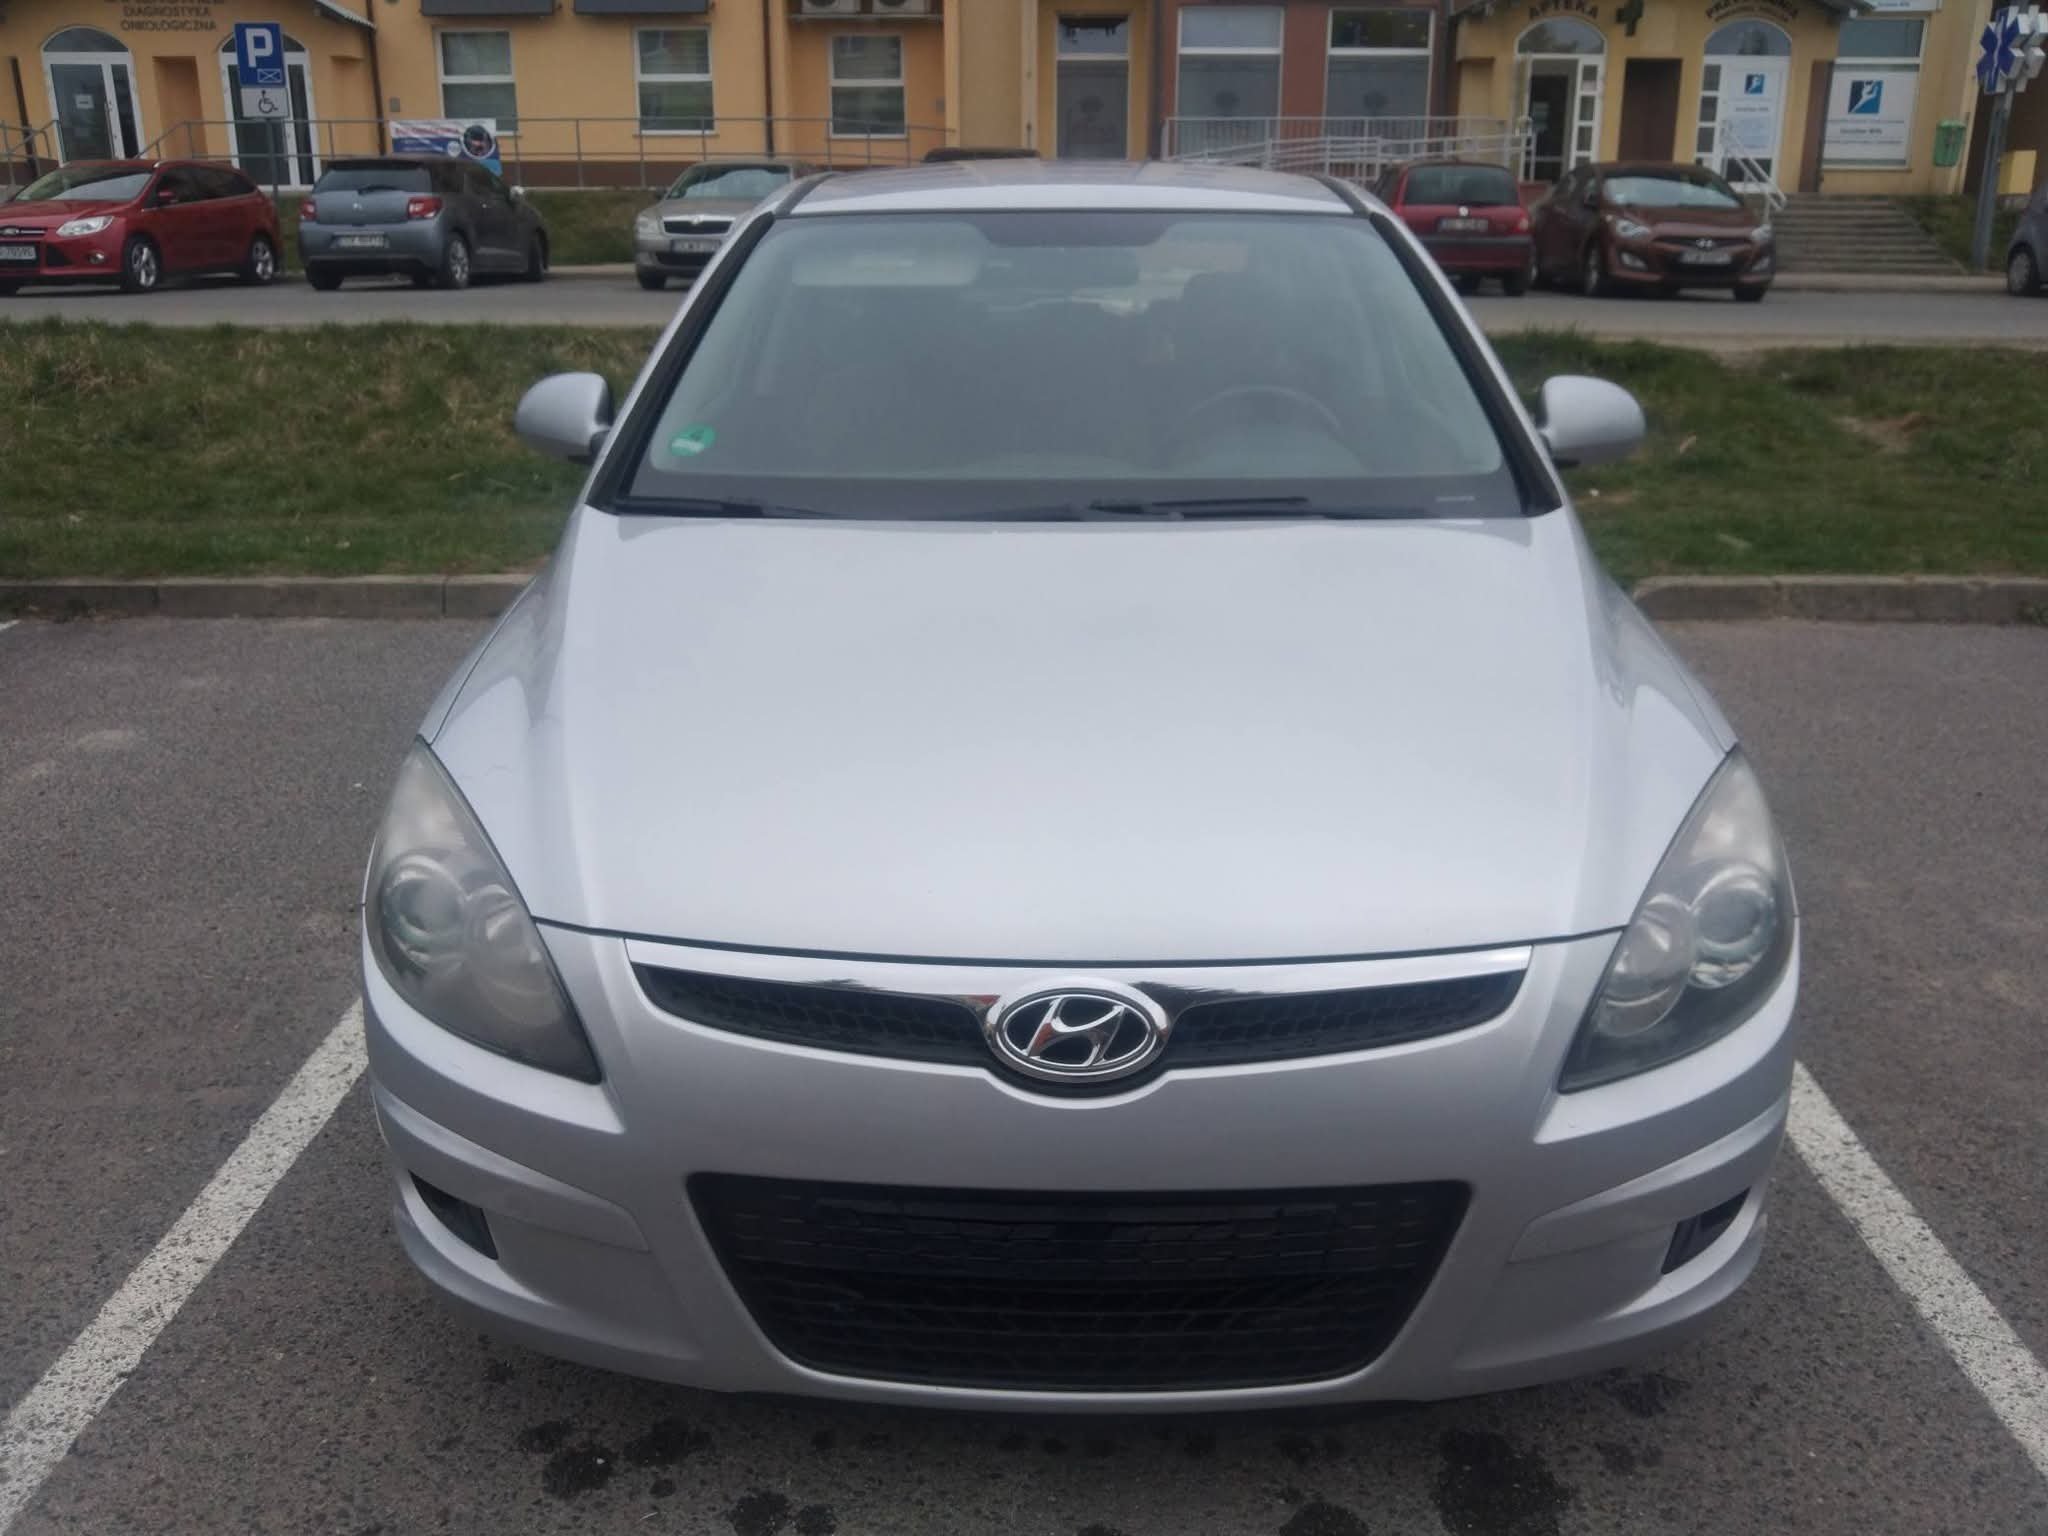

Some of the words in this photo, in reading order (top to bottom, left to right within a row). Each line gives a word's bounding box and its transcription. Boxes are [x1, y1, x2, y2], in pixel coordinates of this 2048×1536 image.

[122, 6, 210, 17] DIAGNOSTYKA
[1529, 0, 1599, 19] APTEKA
[120, 19, 217, 31] ONKOLOGICZNA
[245, 28, 273, 67] P
